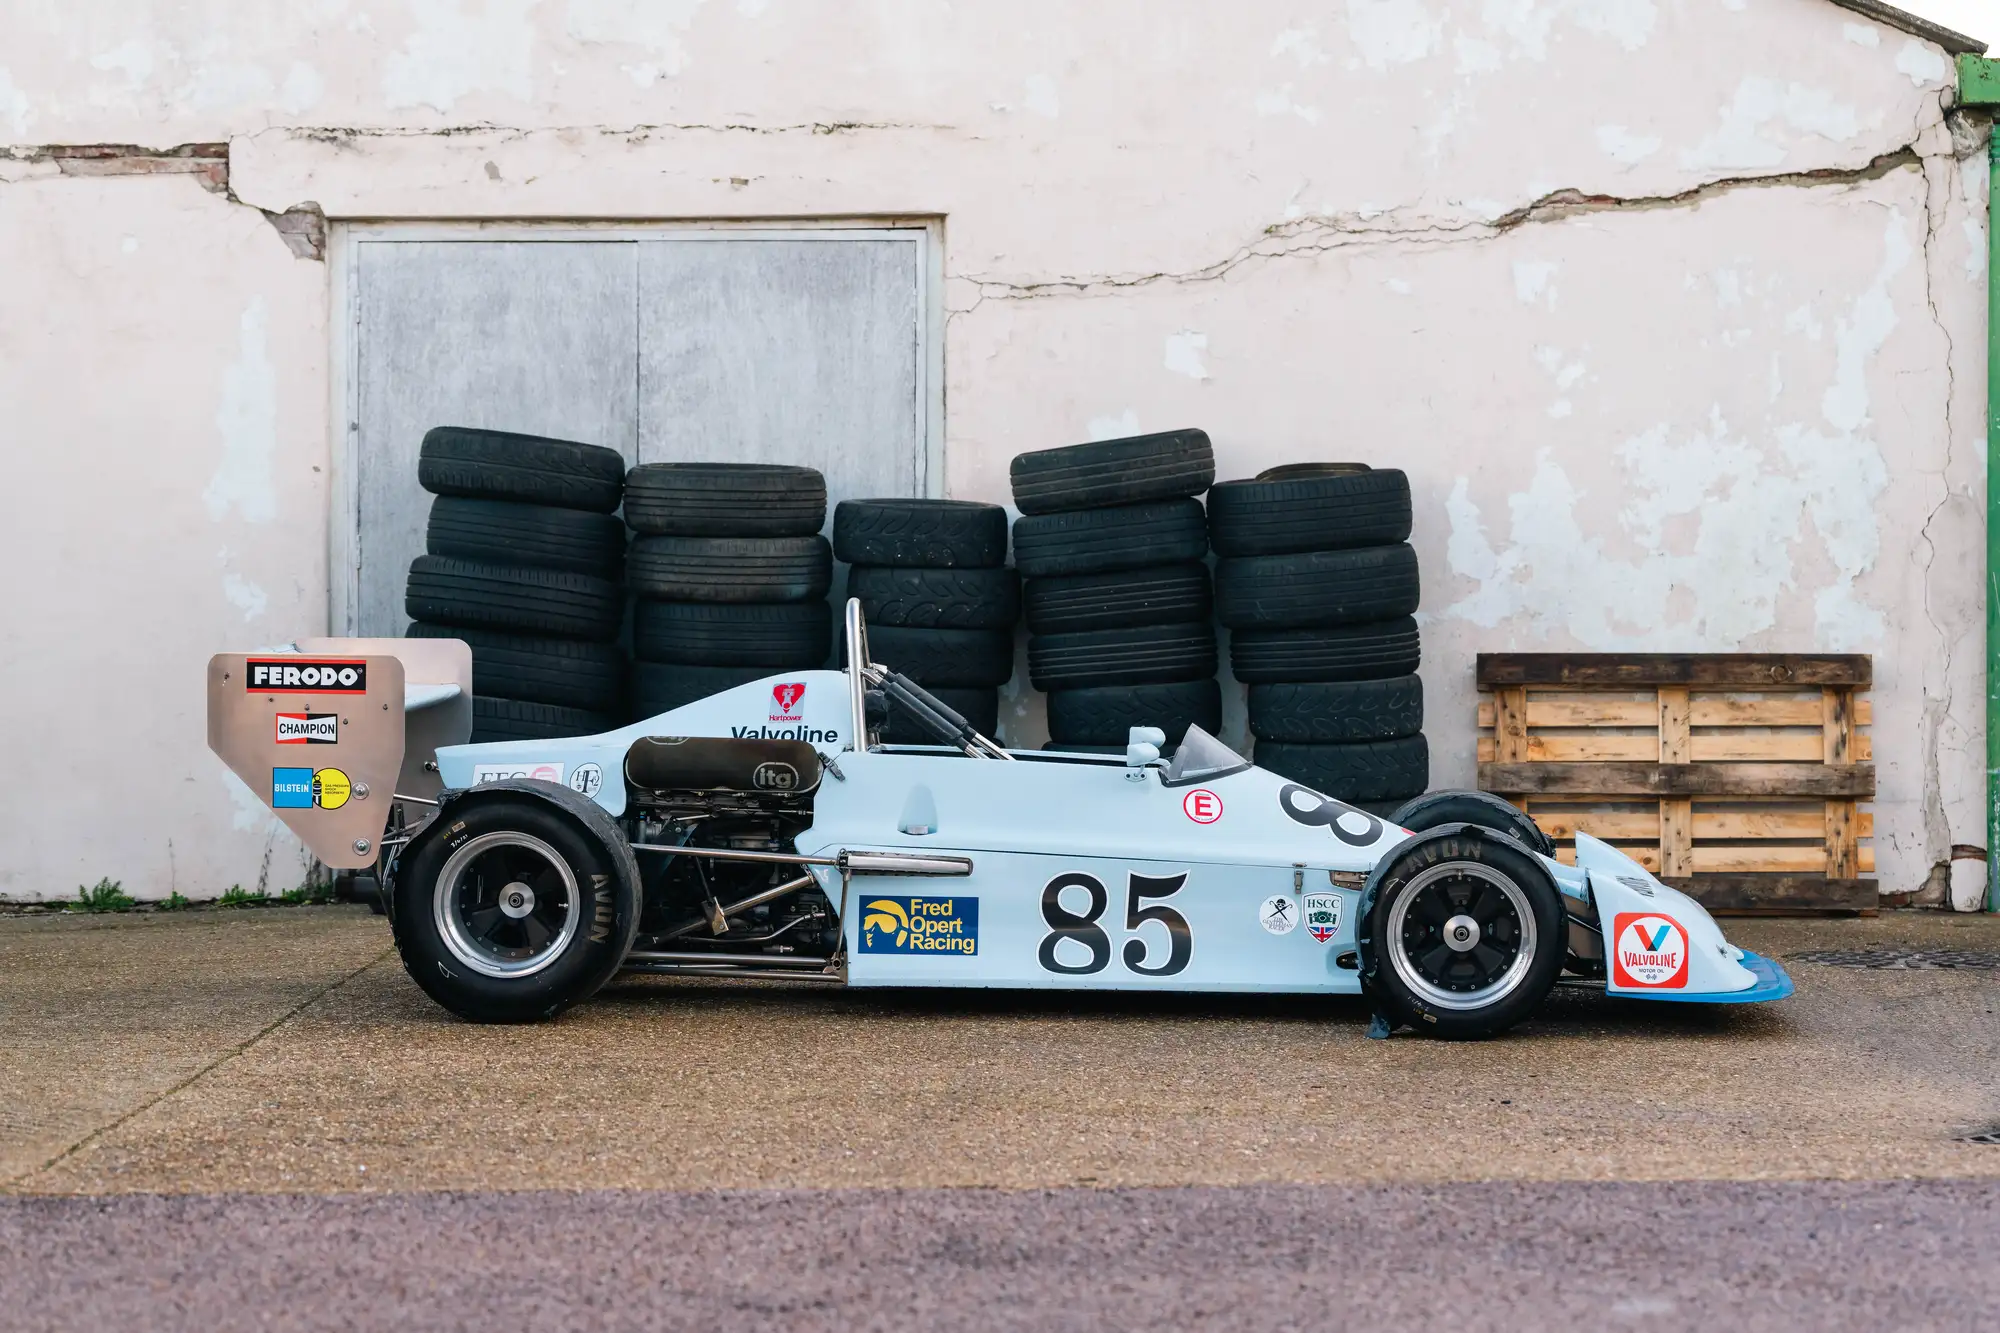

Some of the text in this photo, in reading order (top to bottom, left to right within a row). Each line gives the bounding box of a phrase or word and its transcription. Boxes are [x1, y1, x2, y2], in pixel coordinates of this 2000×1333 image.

[254, 666, 358, 686] FERODO
[279, 722, 335, 735] CHAMPION
[731, 725, 838, 743] Valvoline
[759, 767, 792, 787] itg
[274, 783, 309, 792] BILSTEIN
[1194, 795, 1213, 817] E
[909, 898, 953, 917] Fred
[1307, 899, 1340, 909] HSCC
[909, 917, 963, 937] Opert
[1037, 869, 1194, 976] 85
[909, 934, 975, 955] Racing
[1624, 951, 1676, 969] VALVOLINE
